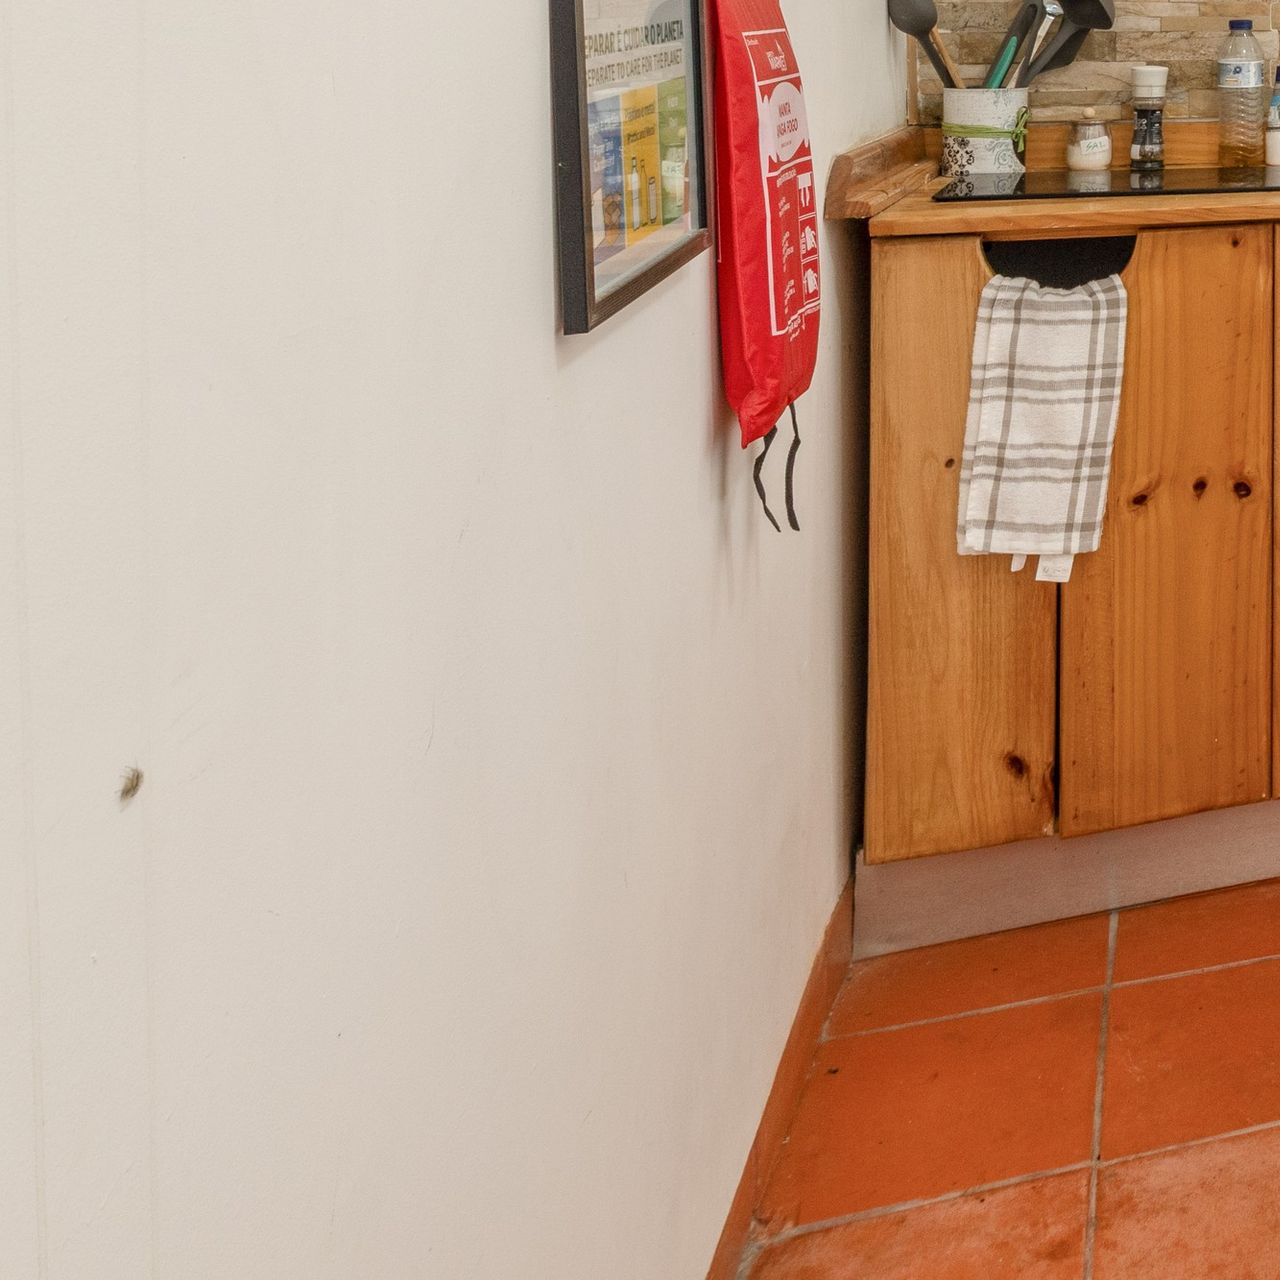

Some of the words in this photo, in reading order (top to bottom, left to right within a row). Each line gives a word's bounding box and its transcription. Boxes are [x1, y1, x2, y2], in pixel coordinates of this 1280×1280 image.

[585, 32, 616, 59] EPARAR
[656, 20, 684, 44] PLANETA
[588, 64, 616, 87] EPARATE
